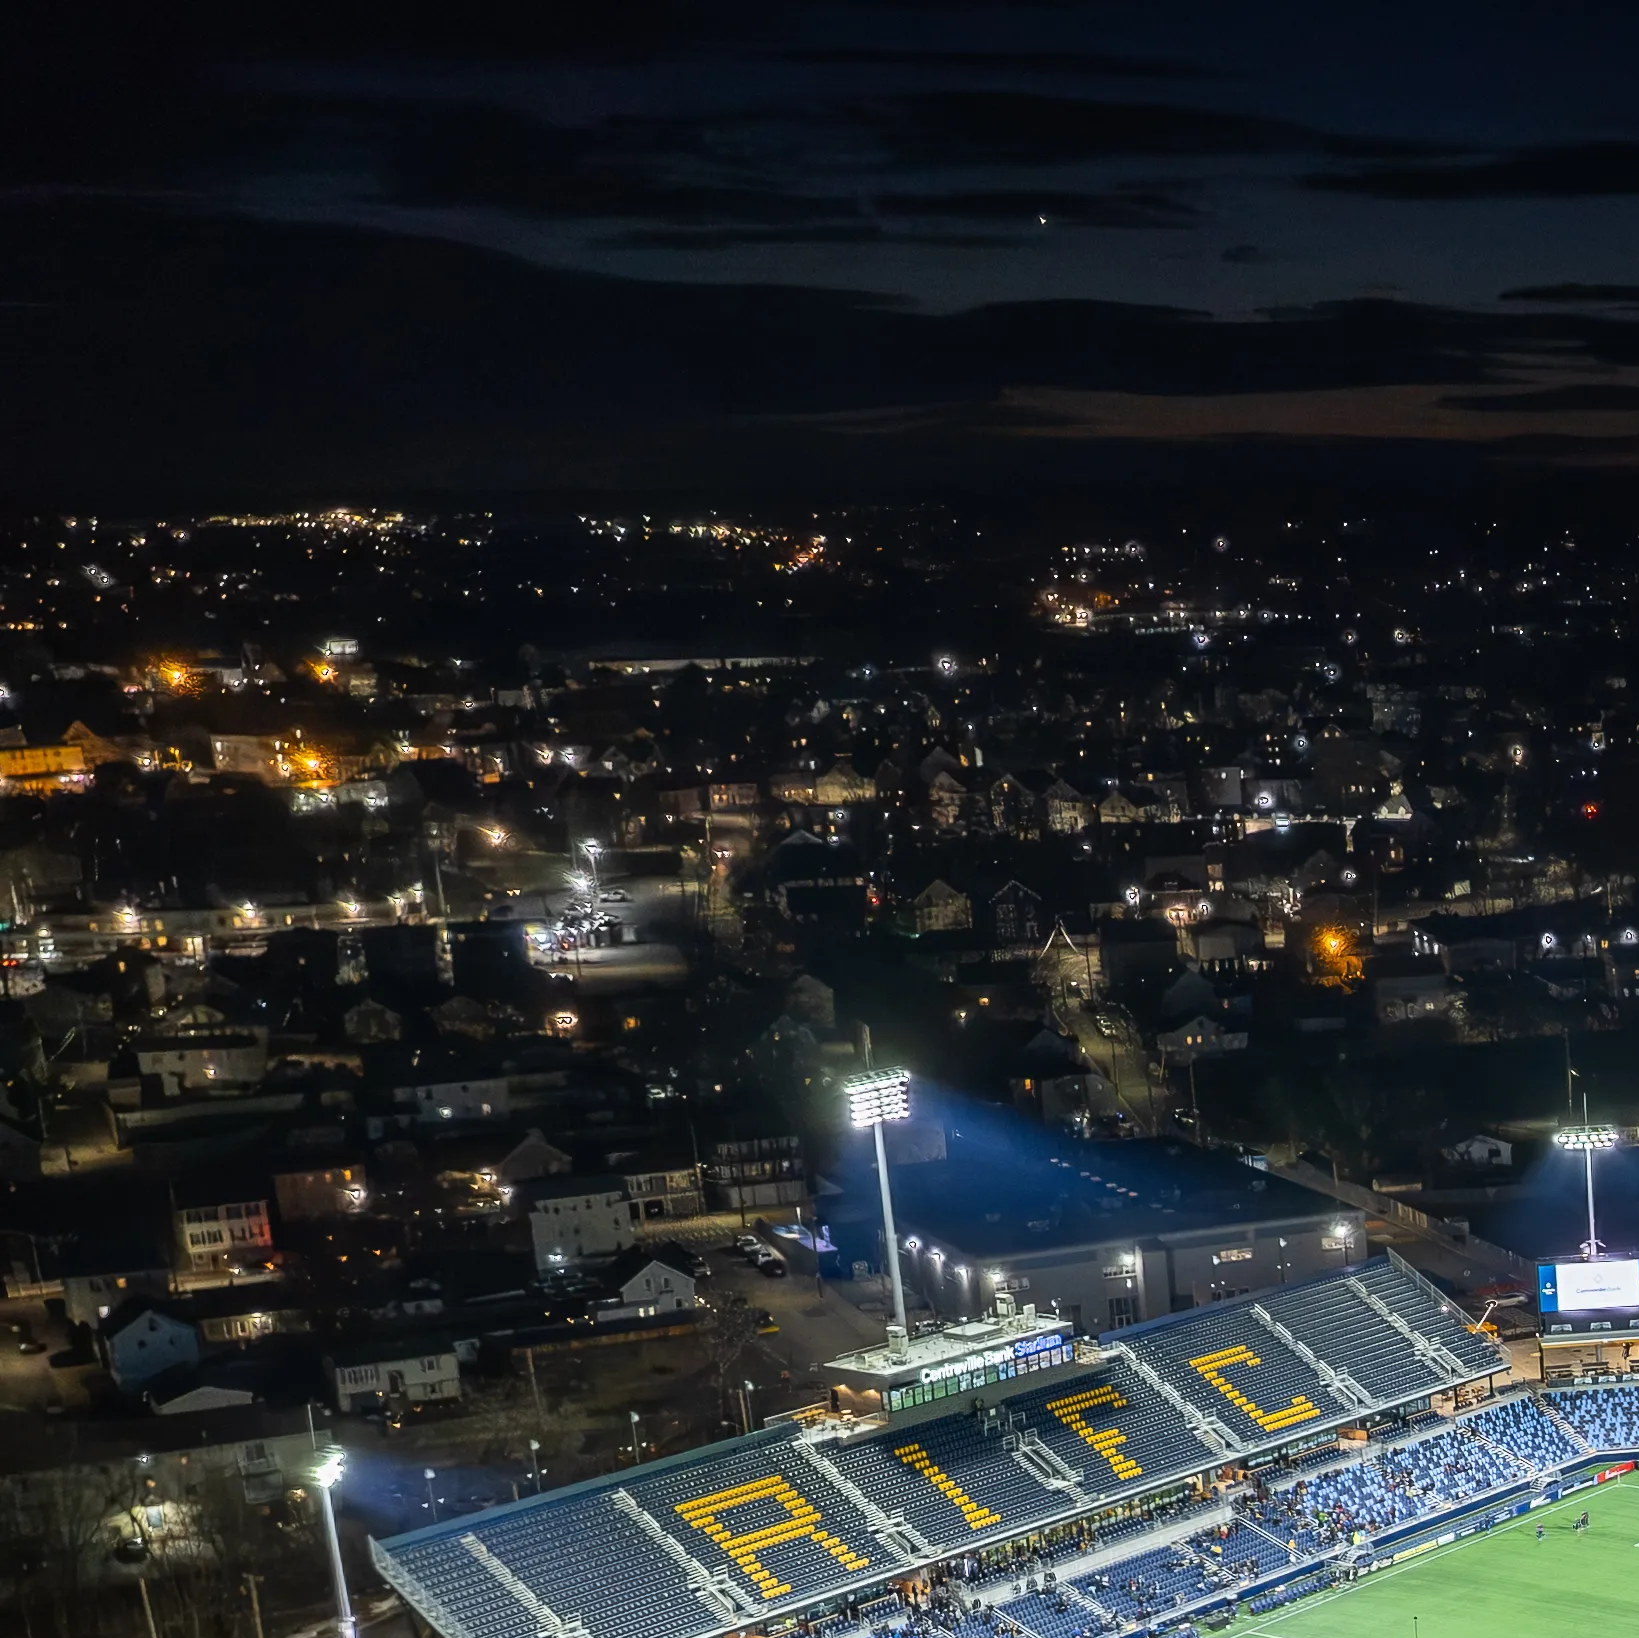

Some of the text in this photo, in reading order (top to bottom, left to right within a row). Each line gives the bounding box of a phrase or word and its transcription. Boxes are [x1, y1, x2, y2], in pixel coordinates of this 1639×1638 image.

[921, 1334, 1063, 1384] Centreville Bank Stadium
